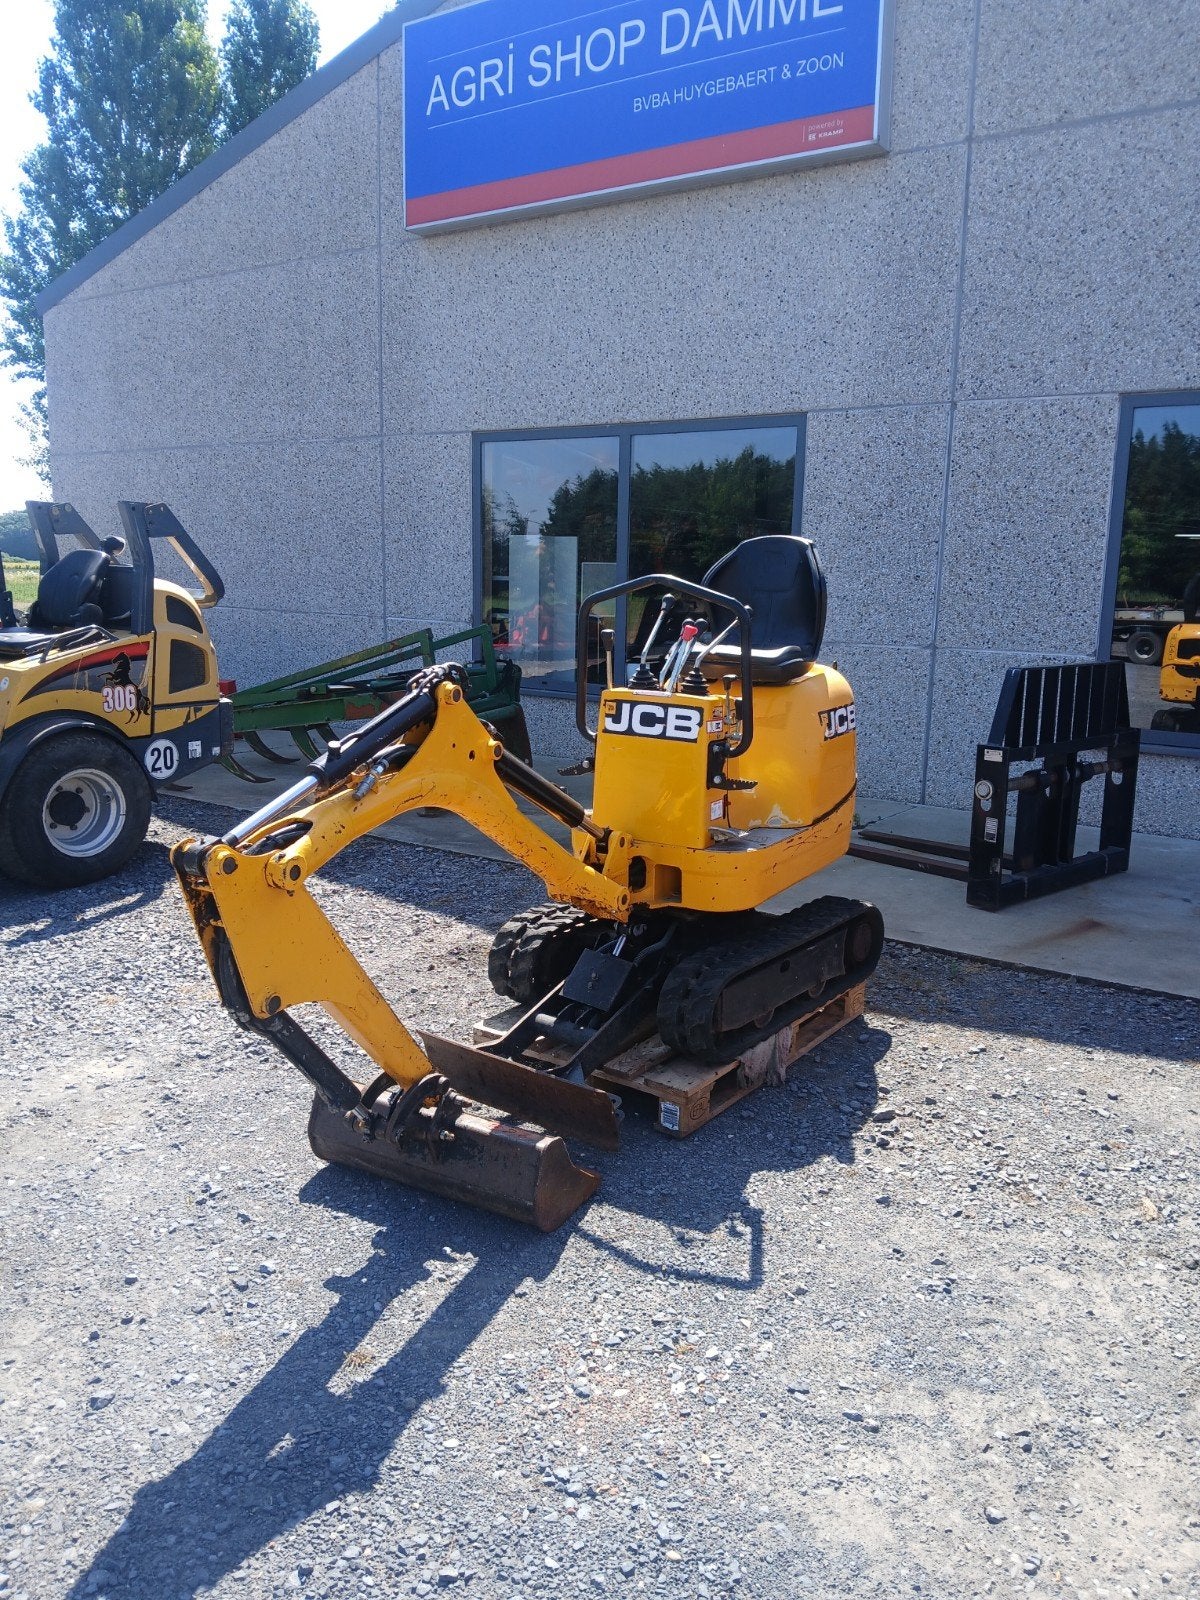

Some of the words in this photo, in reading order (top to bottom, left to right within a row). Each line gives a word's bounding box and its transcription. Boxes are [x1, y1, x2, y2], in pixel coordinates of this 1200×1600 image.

[528, 19, 646, 87] SHOP
[633, 92, 671, 112] BVBA
[674, 66, 776, 103] HUYGEBAERT
[781, 63, 792, 79] &
[796, 52, 844, 77] ZOON
[102, 684, 136, 713] 306
[604, 702, 700, 740] JCB
[825, 704, 856, 738] JCB
[150, 746, 174, 772] 20
